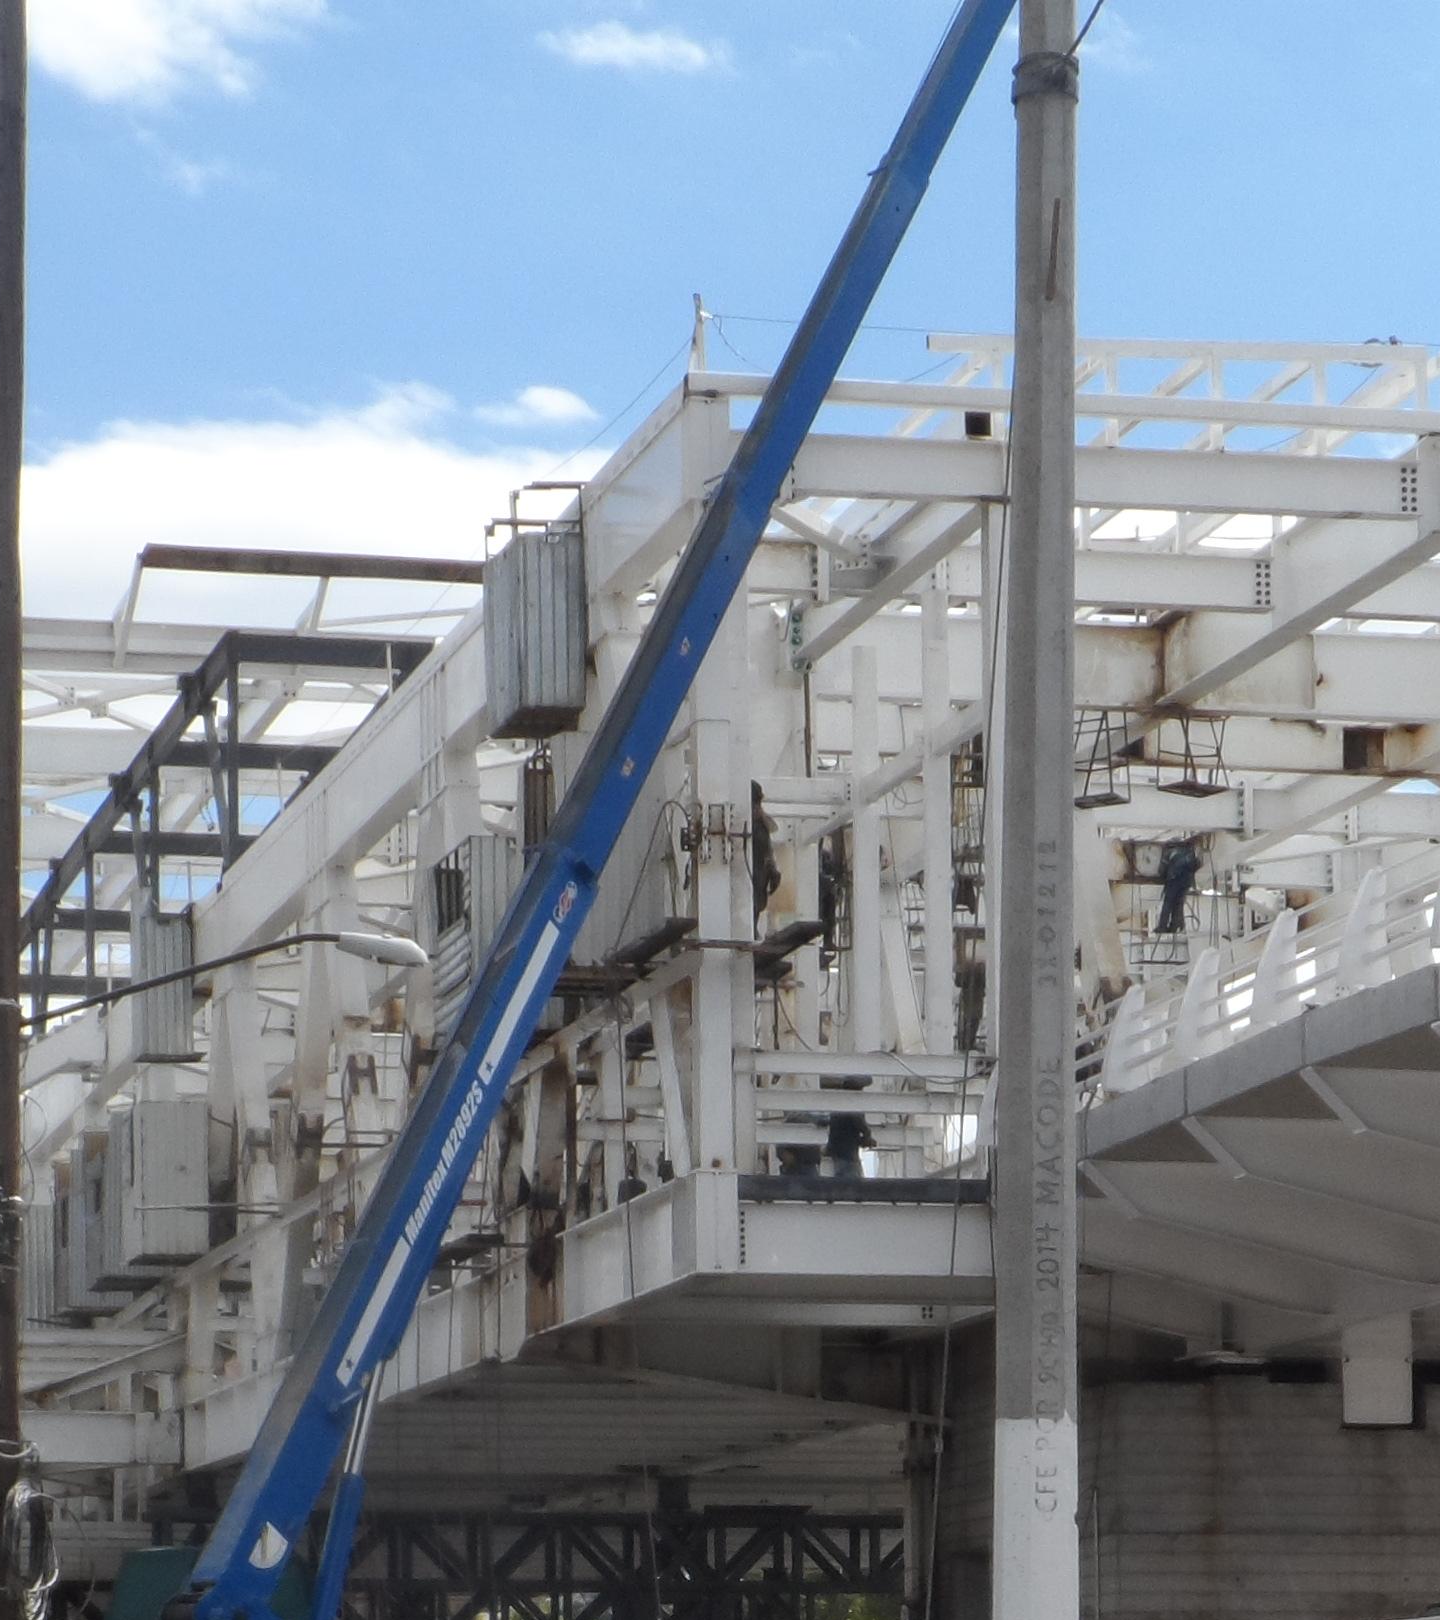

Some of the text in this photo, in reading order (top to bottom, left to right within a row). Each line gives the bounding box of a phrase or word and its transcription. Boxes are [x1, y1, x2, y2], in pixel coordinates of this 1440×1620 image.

[404, 1158, 449, 1246] Manitex
[1036, 1223, 1060, 1291] 2014
[1035, 1466, 1058, 1513] CFE
